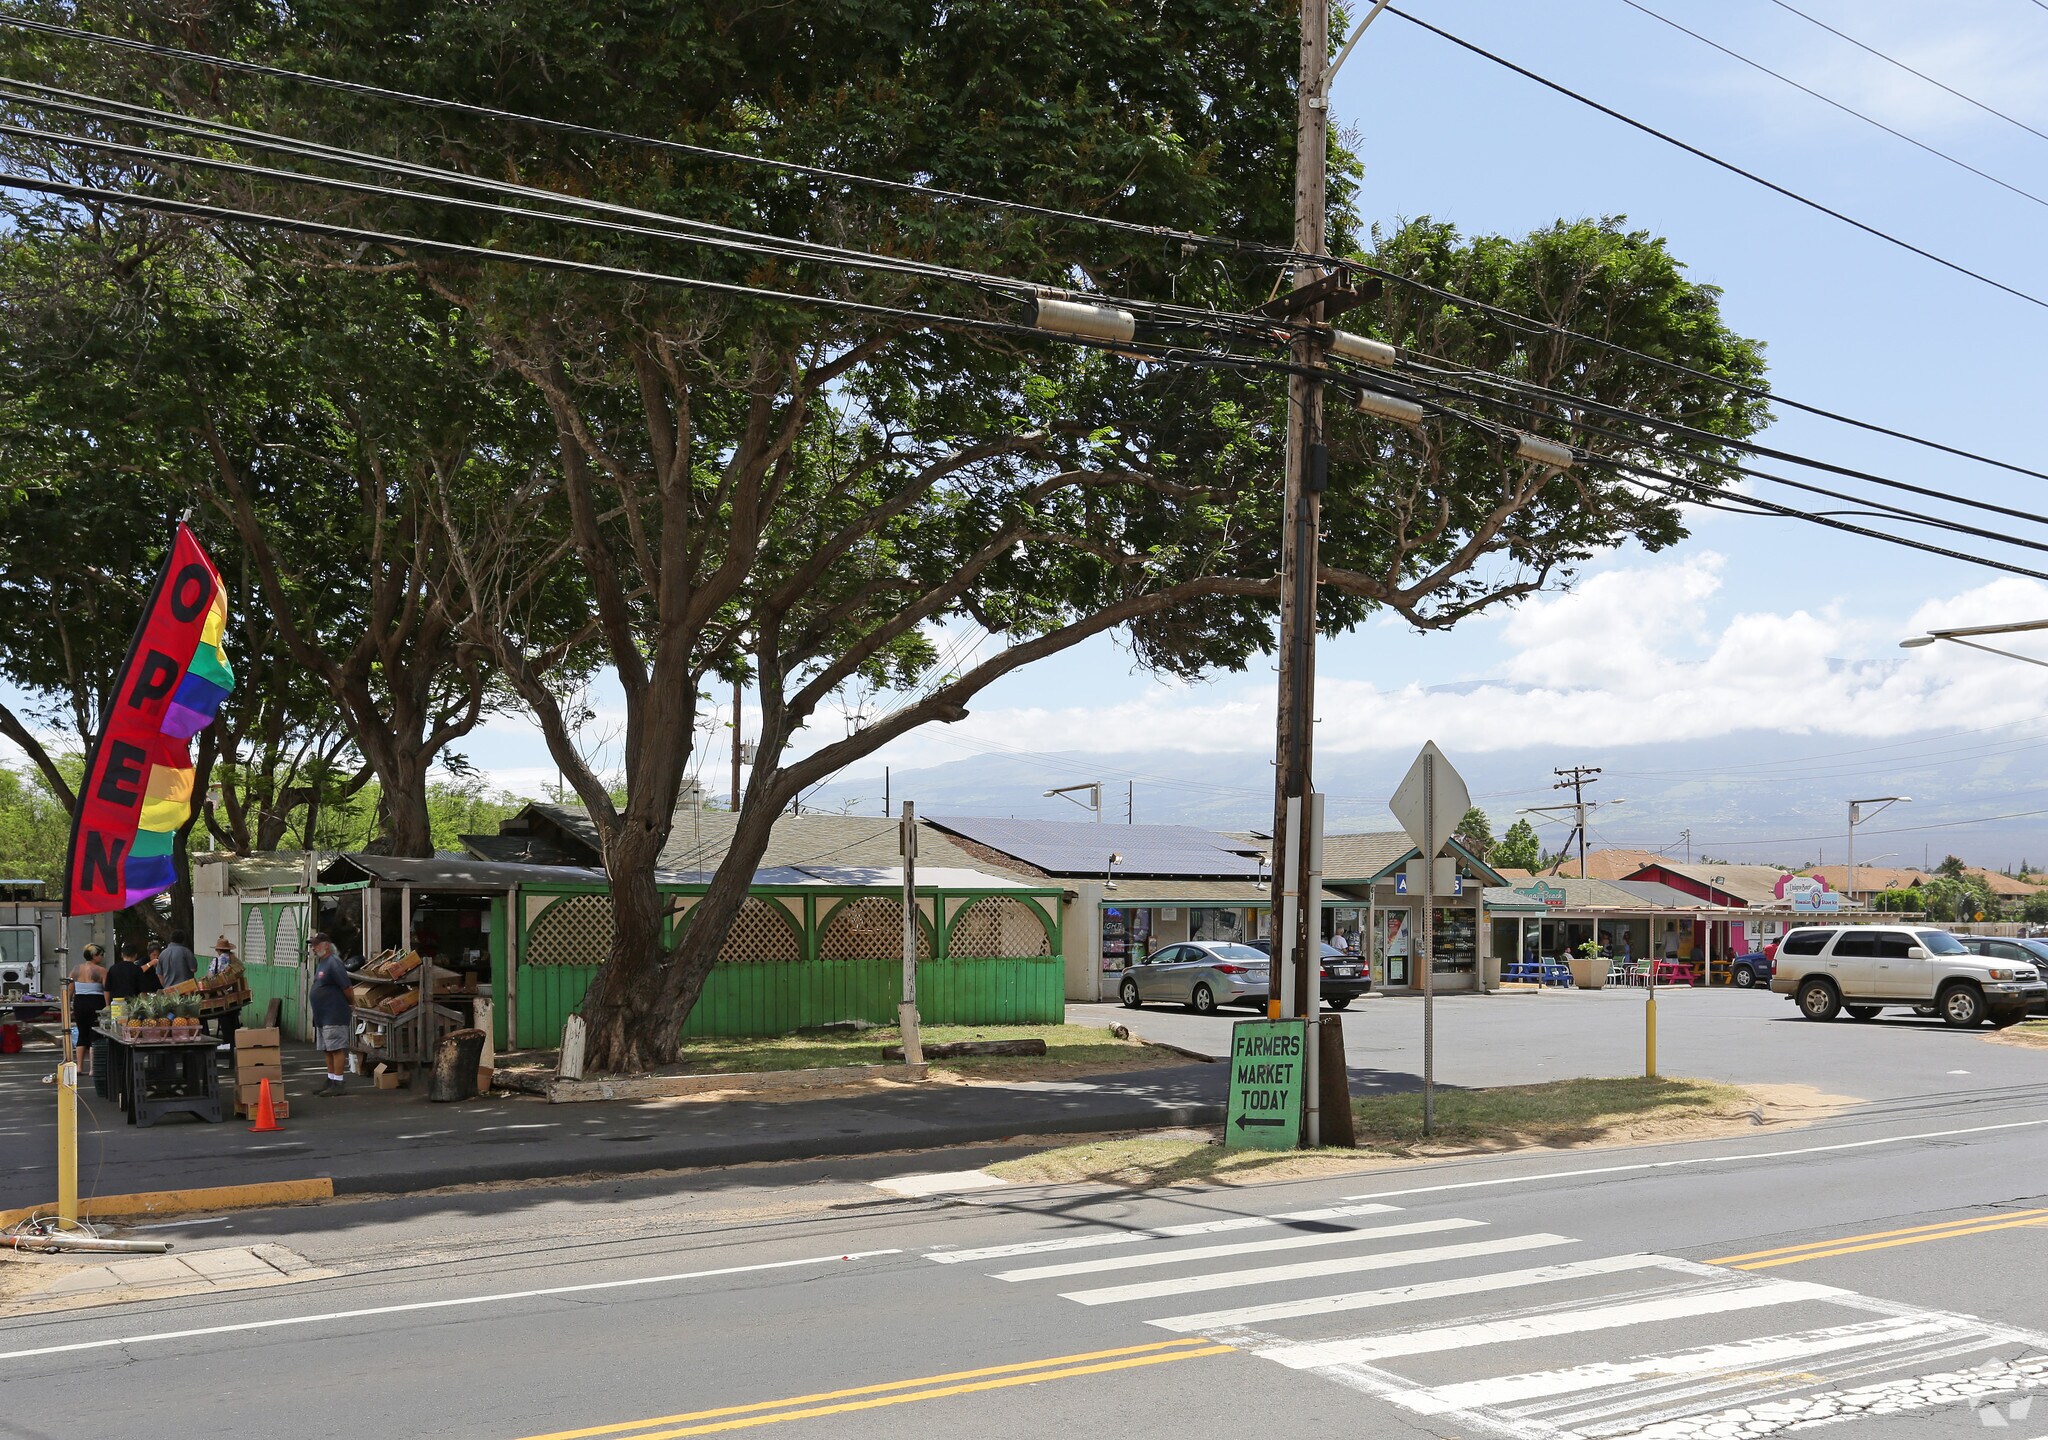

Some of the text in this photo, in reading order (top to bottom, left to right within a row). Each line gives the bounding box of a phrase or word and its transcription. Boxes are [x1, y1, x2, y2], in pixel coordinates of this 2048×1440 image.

[80, 563, 211, 895] OPEN
[1236, 1036, 1300, 1056] FARMERS
[1238, 1064, 1293, 1084] MARKET
[1241, 1090, 1289, 1110] TODAY
